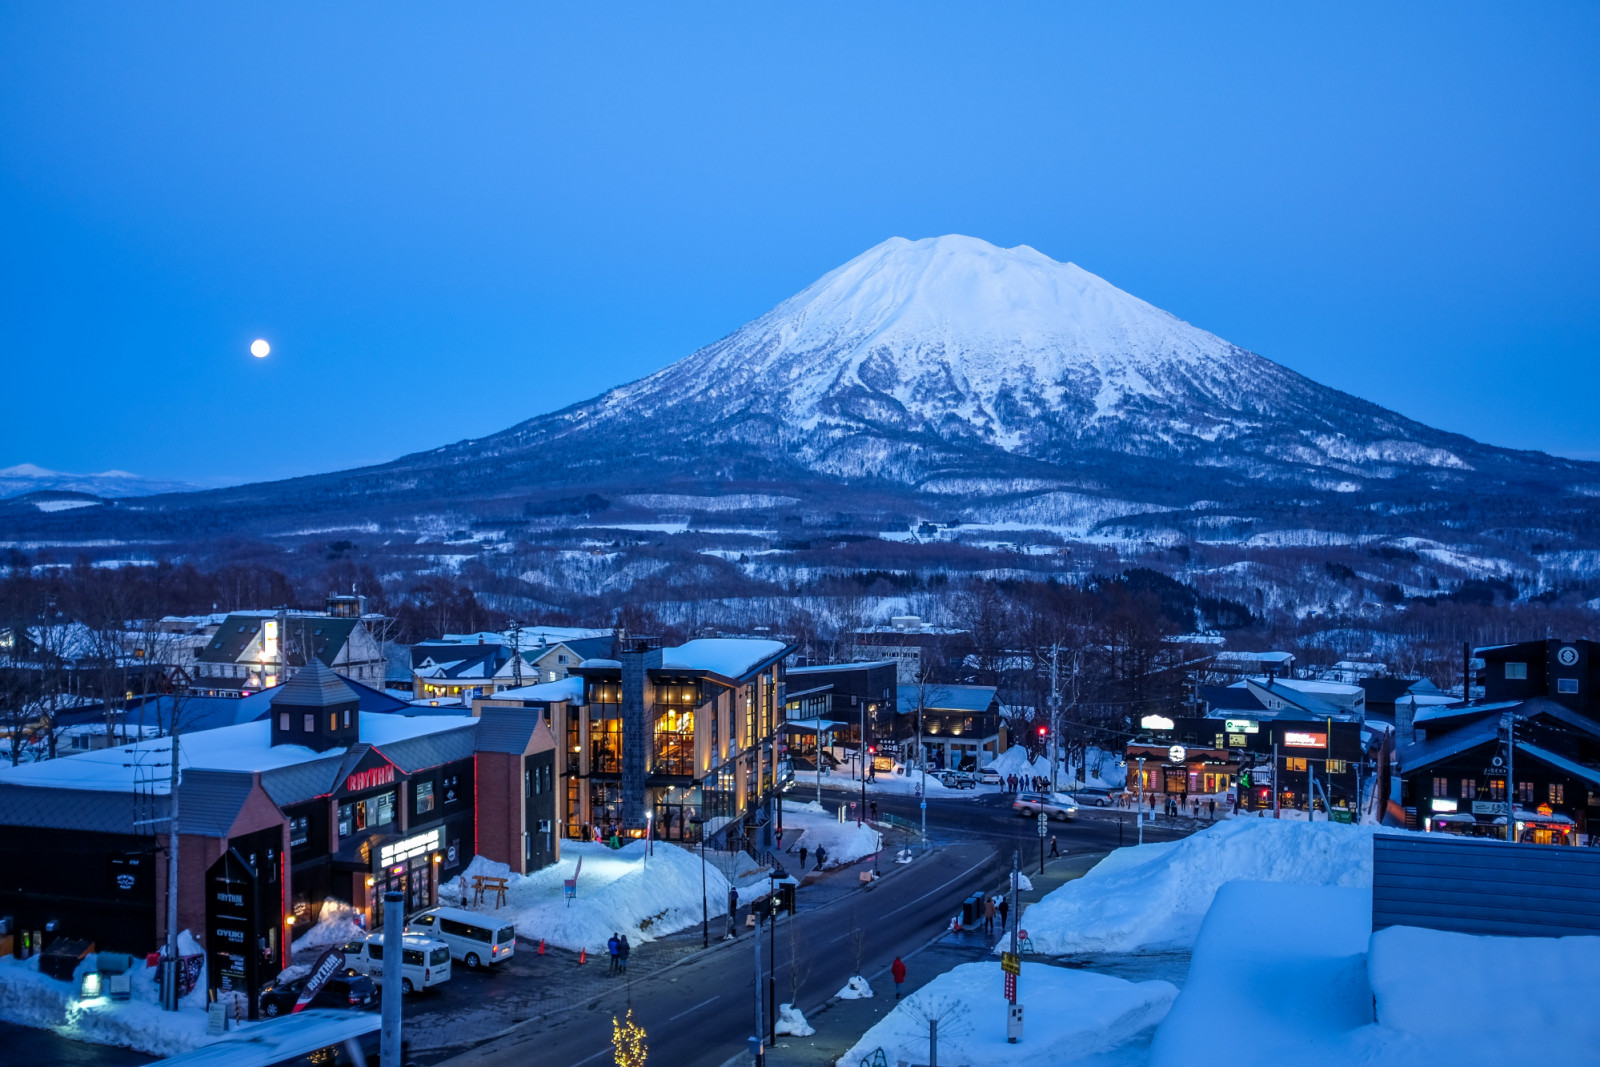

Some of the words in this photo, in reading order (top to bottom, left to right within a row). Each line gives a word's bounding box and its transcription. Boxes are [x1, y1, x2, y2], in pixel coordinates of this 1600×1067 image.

[347, 765, 395, 791] RHYTHM
[217, 893, 242, 903] RHYTHM
[307, 954, 338, 990] RHYTHM
